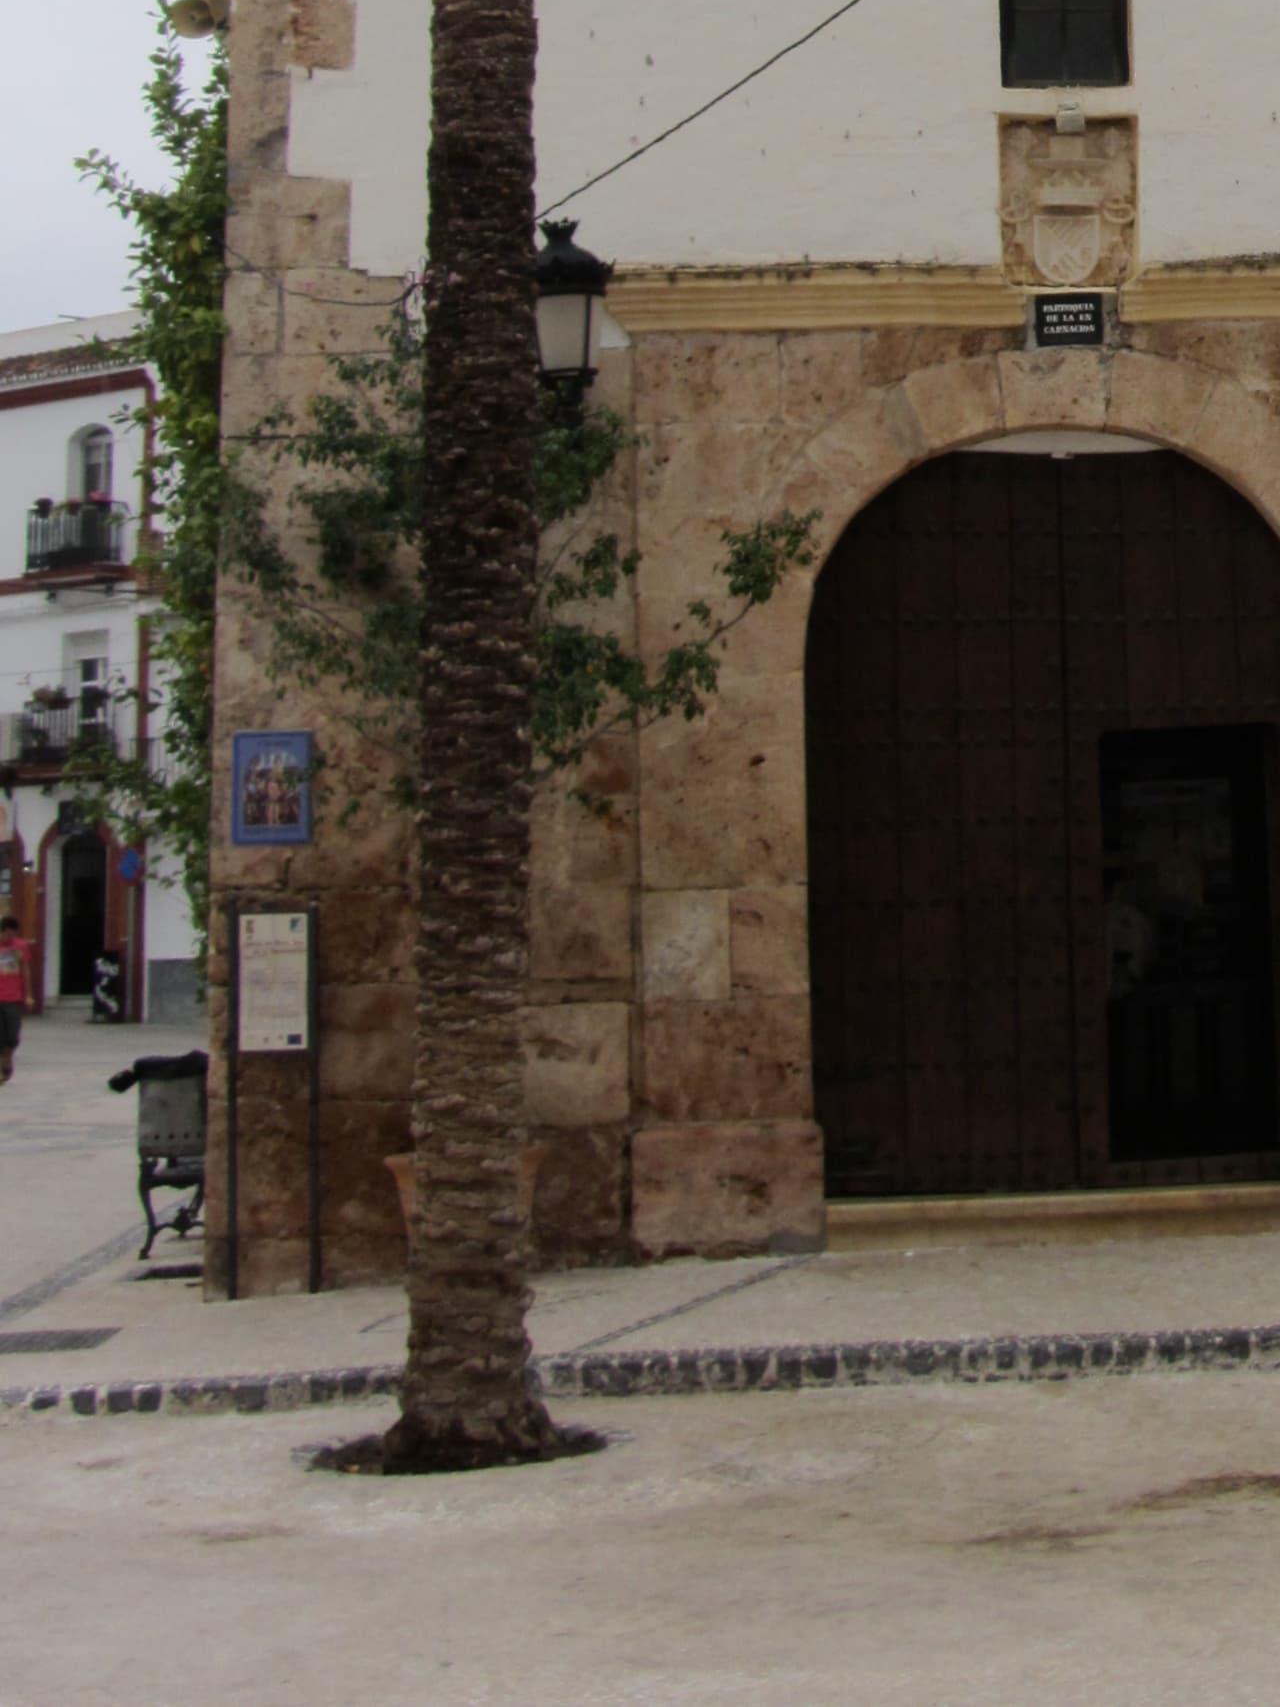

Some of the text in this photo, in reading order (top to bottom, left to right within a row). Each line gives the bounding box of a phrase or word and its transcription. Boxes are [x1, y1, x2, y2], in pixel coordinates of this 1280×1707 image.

[1043, 303, 1094, 313] PARROQUIA
[1046, 314, 1058, 322] DE
[1079, 313, 1092, 321] EN
